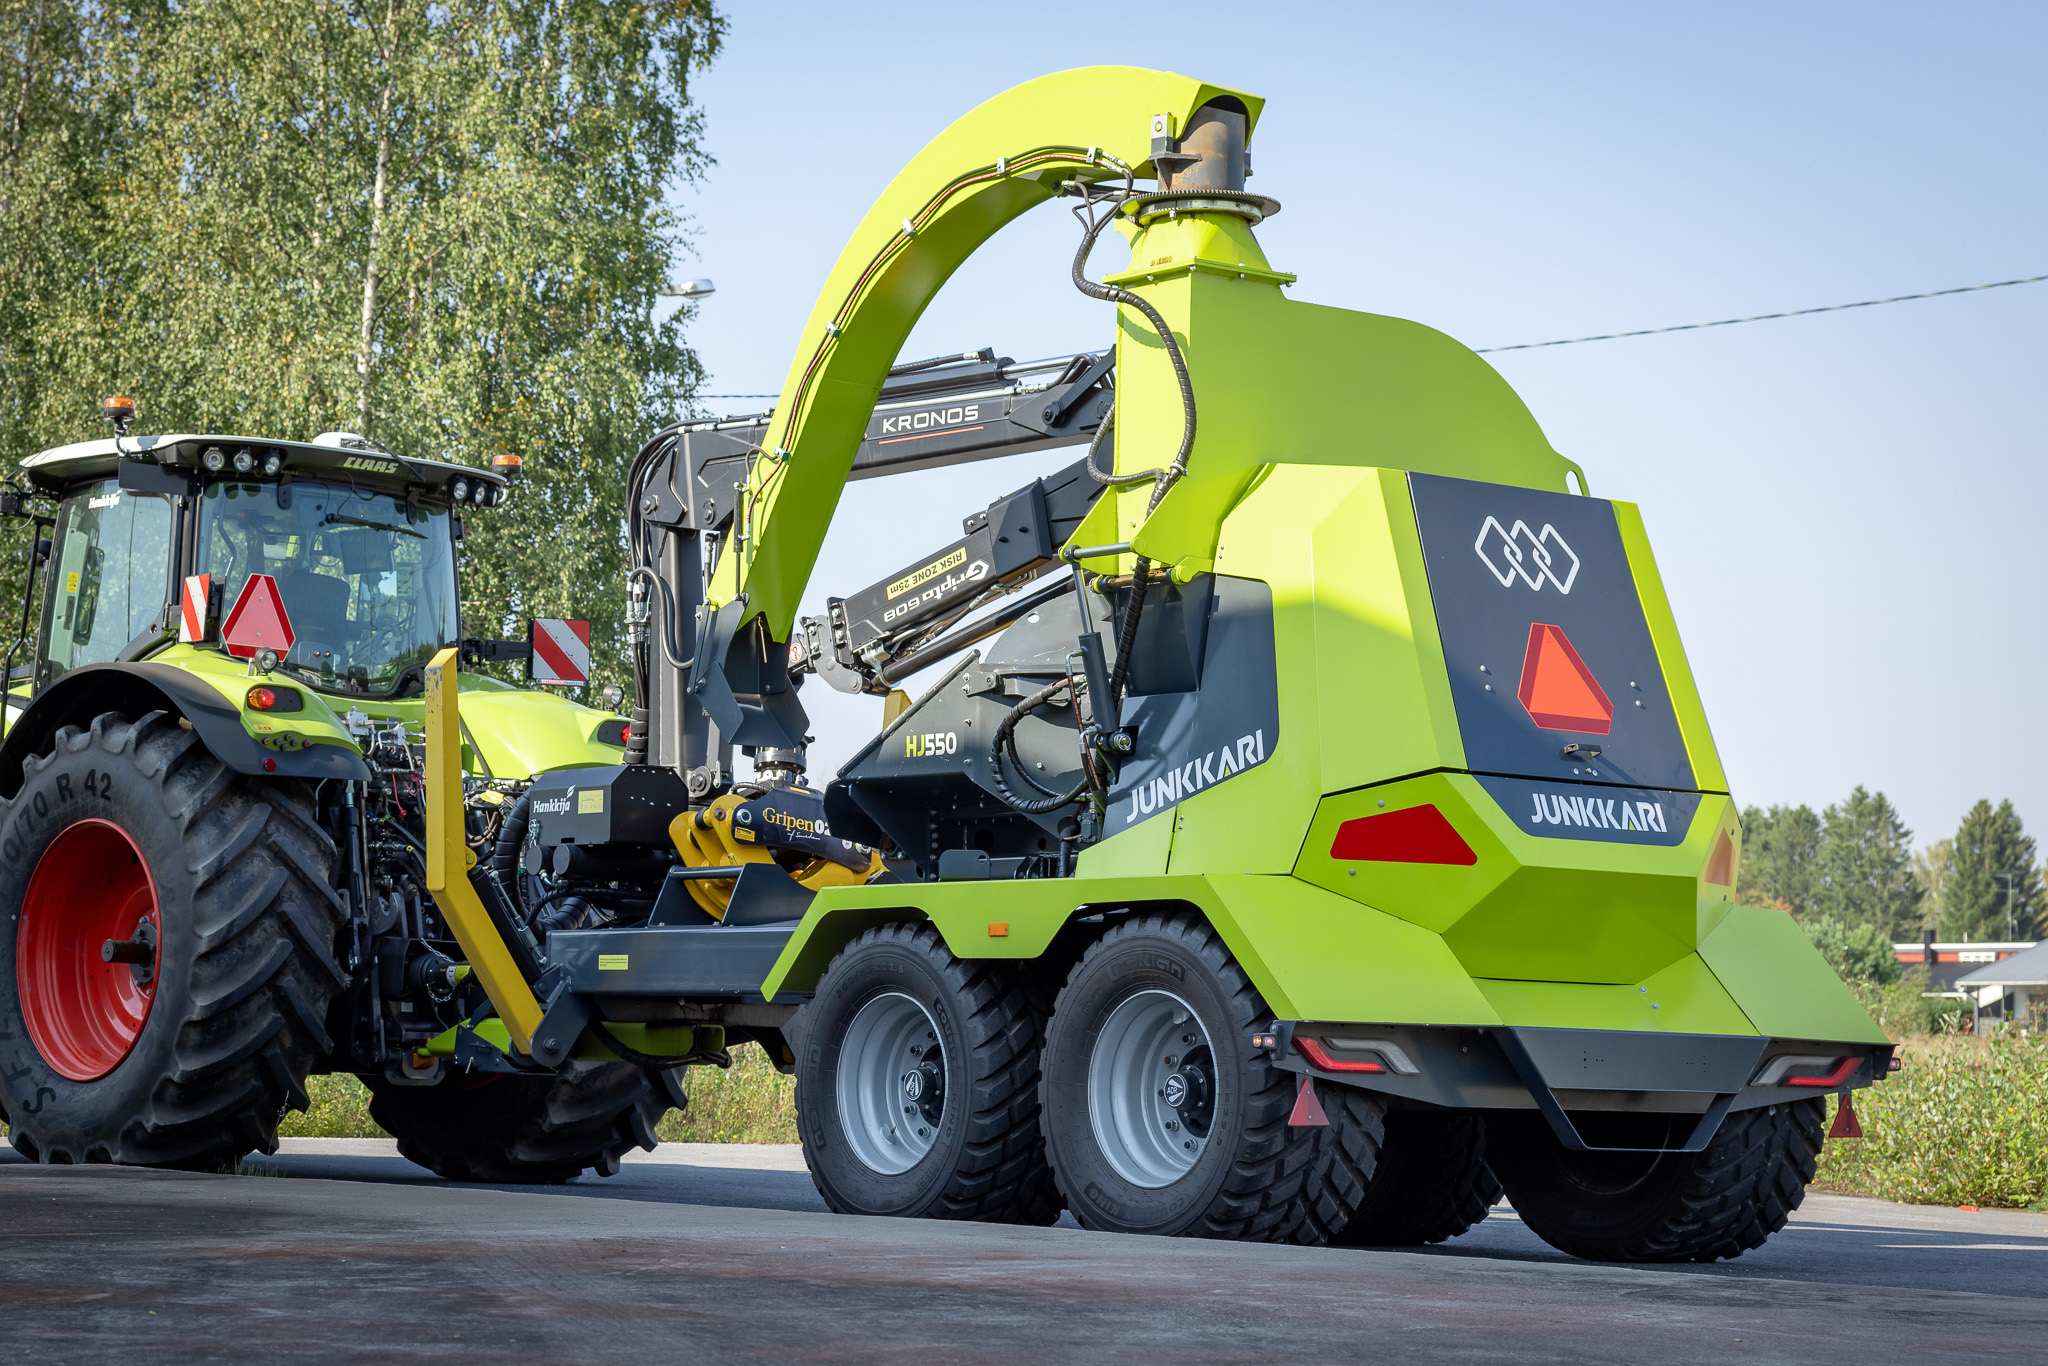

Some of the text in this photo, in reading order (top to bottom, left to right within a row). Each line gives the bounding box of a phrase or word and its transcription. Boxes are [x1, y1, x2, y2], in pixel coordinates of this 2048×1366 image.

[883, 405, 979, 434] KRONOS
[343, 456, 399, 474] CLAAS
[890, 551, 963, 594] RISK ZONE 25m
[884, 560, 989, 623] Gripta 608
[906, 732, 957, 758] HJ550
[56, 773, 74, 802] R
[84, 768, 112, 801] 42
[1127, 728, 1265, 824] JUNKKARI
[533, 798, 571, 816] Hankkija
[1531, 793, 1668, 833] JUNKKARI
[1166, 1086, 1178, 1094] ADR
